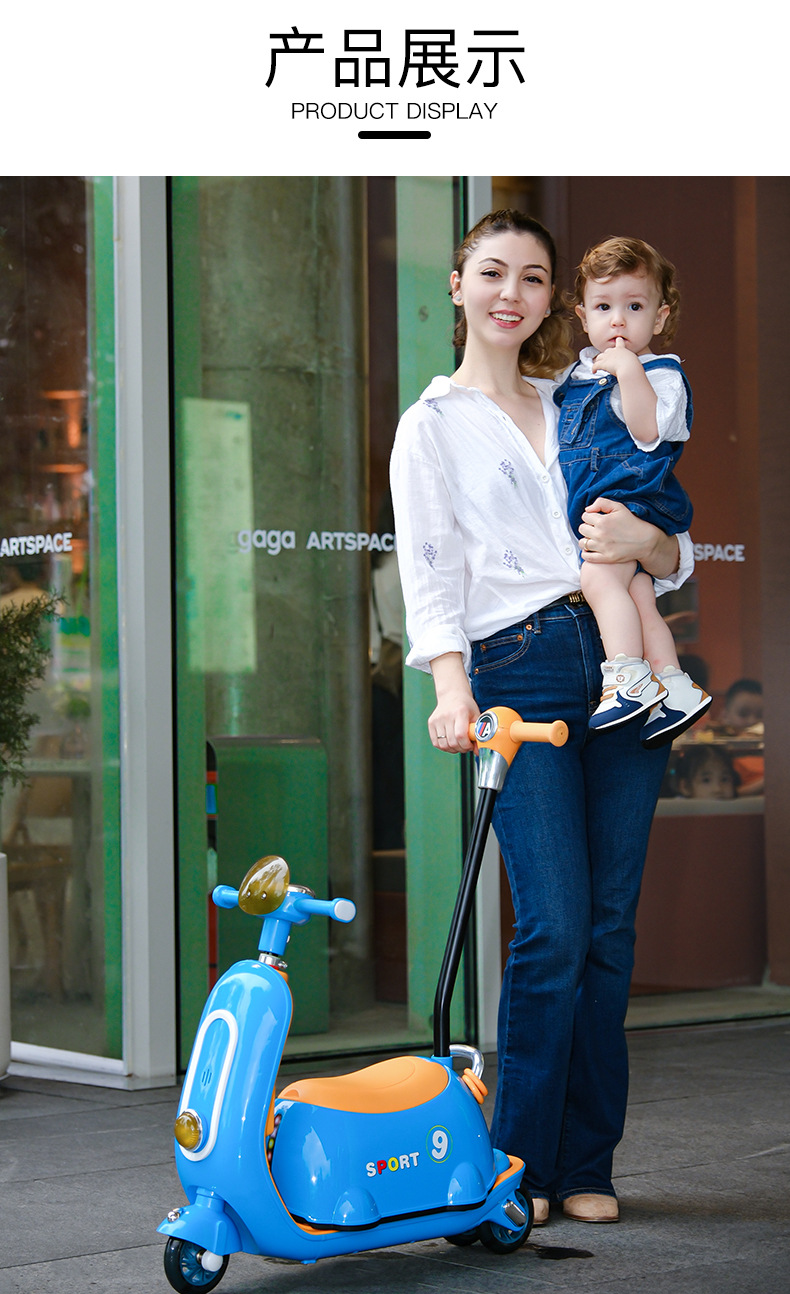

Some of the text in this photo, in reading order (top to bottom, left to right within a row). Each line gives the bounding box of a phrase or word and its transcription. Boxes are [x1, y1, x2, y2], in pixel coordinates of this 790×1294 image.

[0, 532, 73, 558] ARTSPACE
[237, 529, 397, 556] gaga ARTSPAC
[693, 543, 746, 562] SPACE
[431, 1130, 448, 1160] 9
[366, 1151, 420, 1178] SPORT
